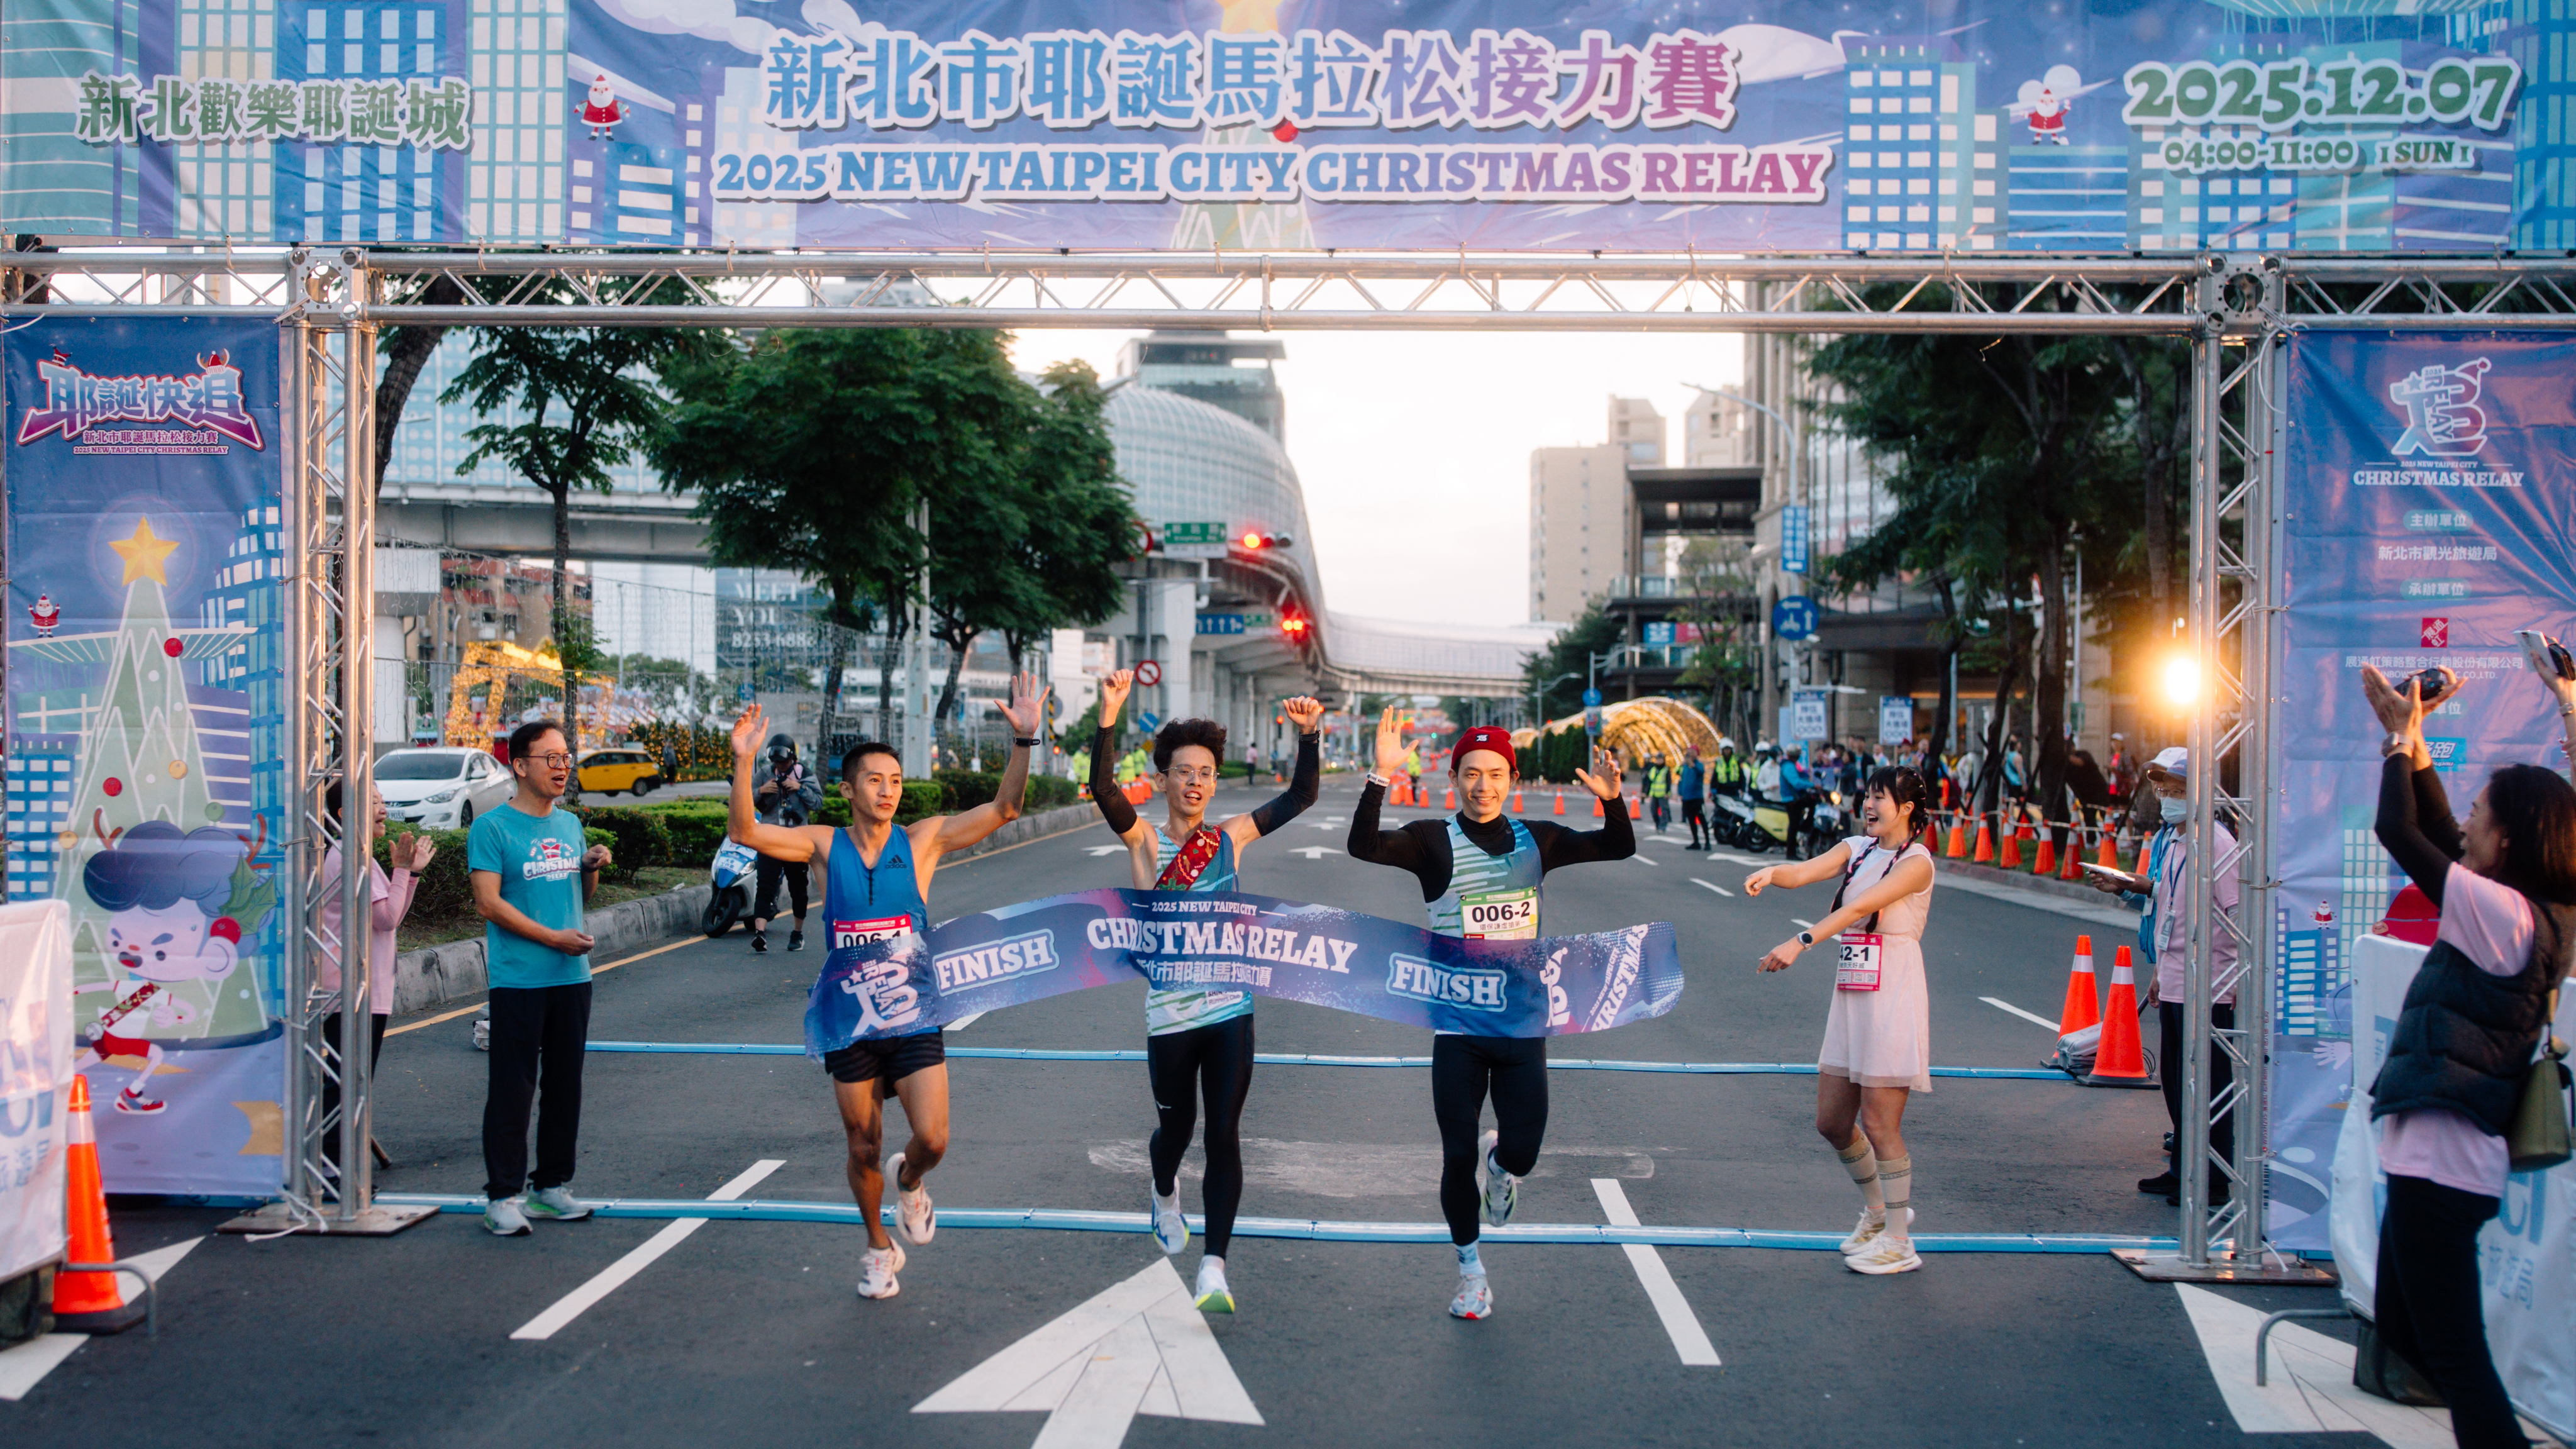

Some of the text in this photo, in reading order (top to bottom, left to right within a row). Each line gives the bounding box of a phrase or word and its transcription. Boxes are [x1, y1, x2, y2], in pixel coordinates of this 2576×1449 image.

[767, 35, 1729, 122] 新北市耶誕馬拉松接力賽
[2129, 64, 2514, 125] 2025.12.07
[79, 74, 465, 145] 新北歡樂耶誕城
[2165, 140, 2355, 167] 04:00-11:00
[718, 152, 1825, 194] 2025 NEW TAIPEI CITY CHRISTMAS RELAY
[84, 431, 218, 443] 新北市耶誕馬拉松接力賽
[2353, 471, 2524, 487] CHRISTMAS RELAY
[2410, 513, 2467, 527] 主辦單位
[2378, 546, 2497, 561] 新北市觀光旅遊局
[2408, 582, 2464, 596] 承辦單位
[1152, 901, 1258, 916] 2025 NEW TAIPEI CITY
[1472, 901, 1530, 923] 006-2
[1087, 918, 1245, 956] CHRISTMAS
[1246, 925, 1358, 974] RELAY
[862, 959, 877, 969] 2025
[938, 933, 1053, 990] FINISH
[1392, 960, 1501, 1005] FINISH
